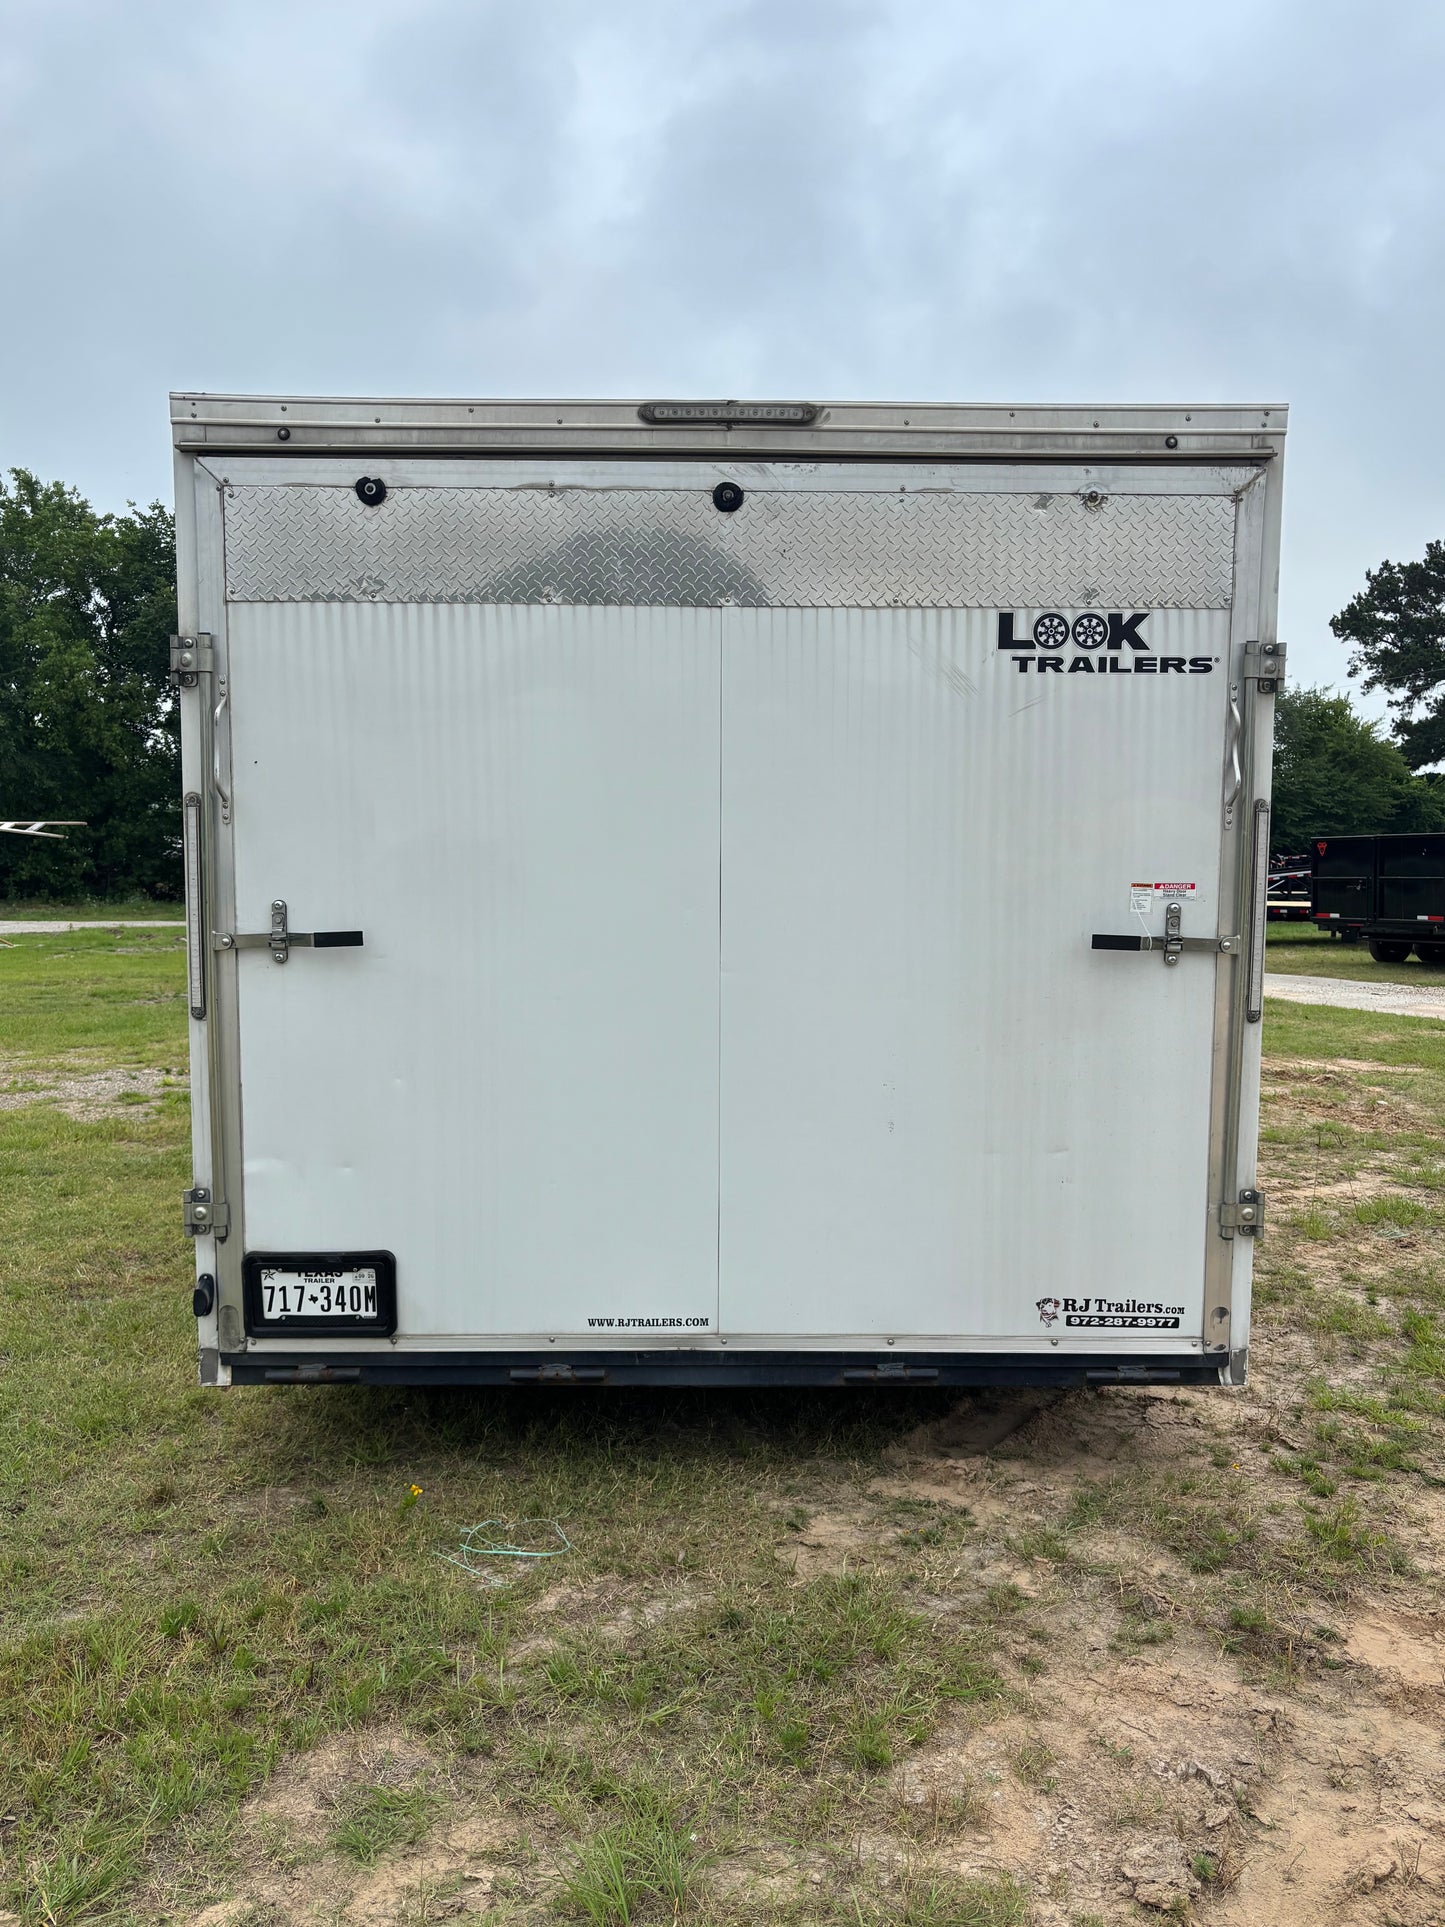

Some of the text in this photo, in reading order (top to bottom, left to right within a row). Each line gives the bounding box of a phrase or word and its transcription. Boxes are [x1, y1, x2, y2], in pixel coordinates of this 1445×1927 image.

[998, 611, 1151, 650] LOOK
[1062, 1297, 1091, 1312] RJ
[587, 1317, 710, 1327] WWW.RJTRAILERS.COM
[1070, 1316, 1176, 1327] 972-287-9977
